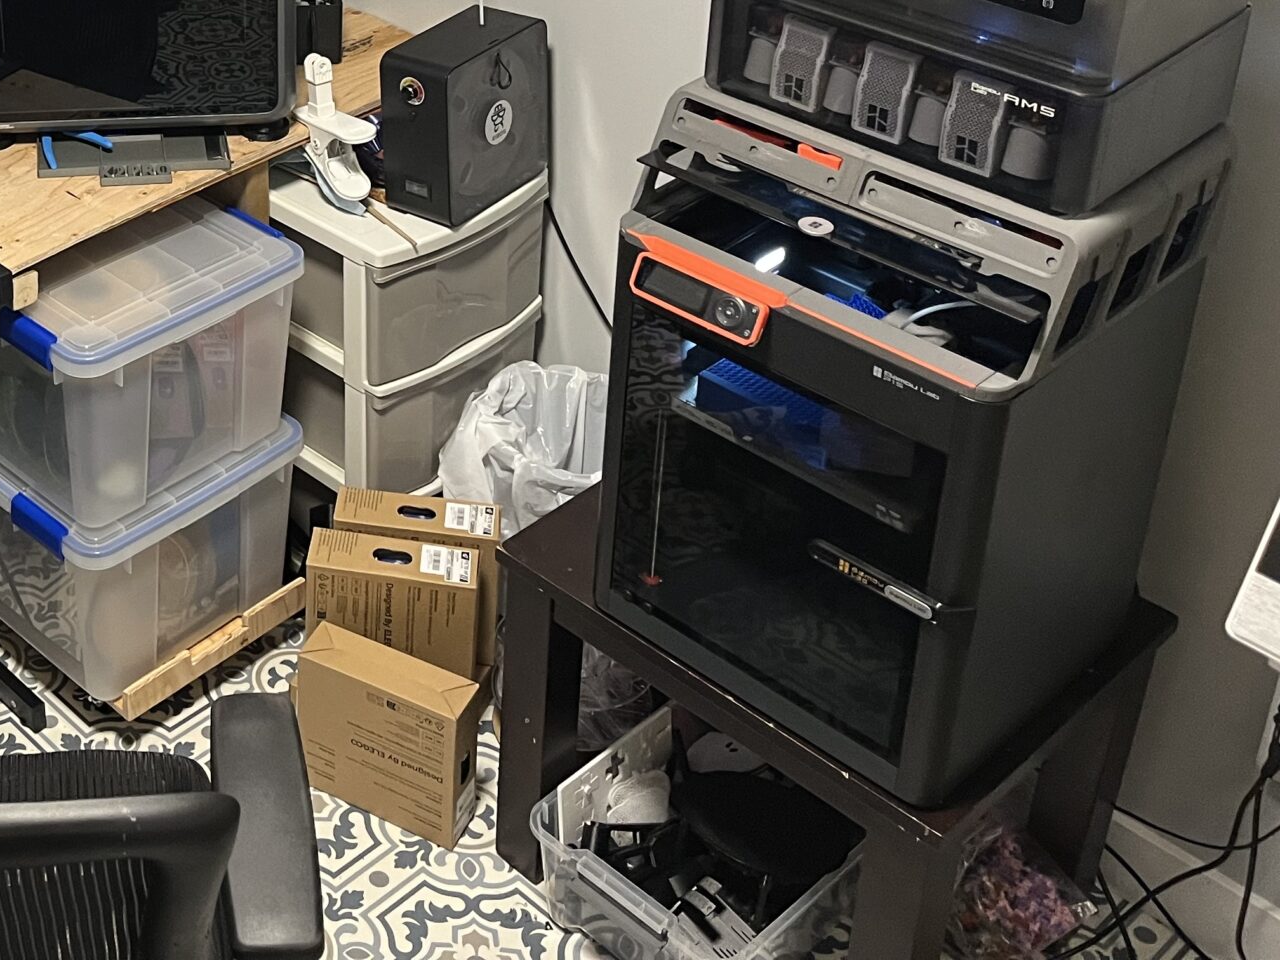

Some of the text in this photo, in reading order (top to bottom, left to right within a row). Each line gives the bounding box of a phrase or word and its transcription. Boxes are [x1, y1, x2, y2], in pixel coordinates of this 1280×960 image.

[1003, 93, 1056, 118] AMS
[920, 387, 940, 401] Lab
[383, 583, 394, 617] Designed
[383, 618, 392, 628] By
[401, 761, 443, 784] Designed
